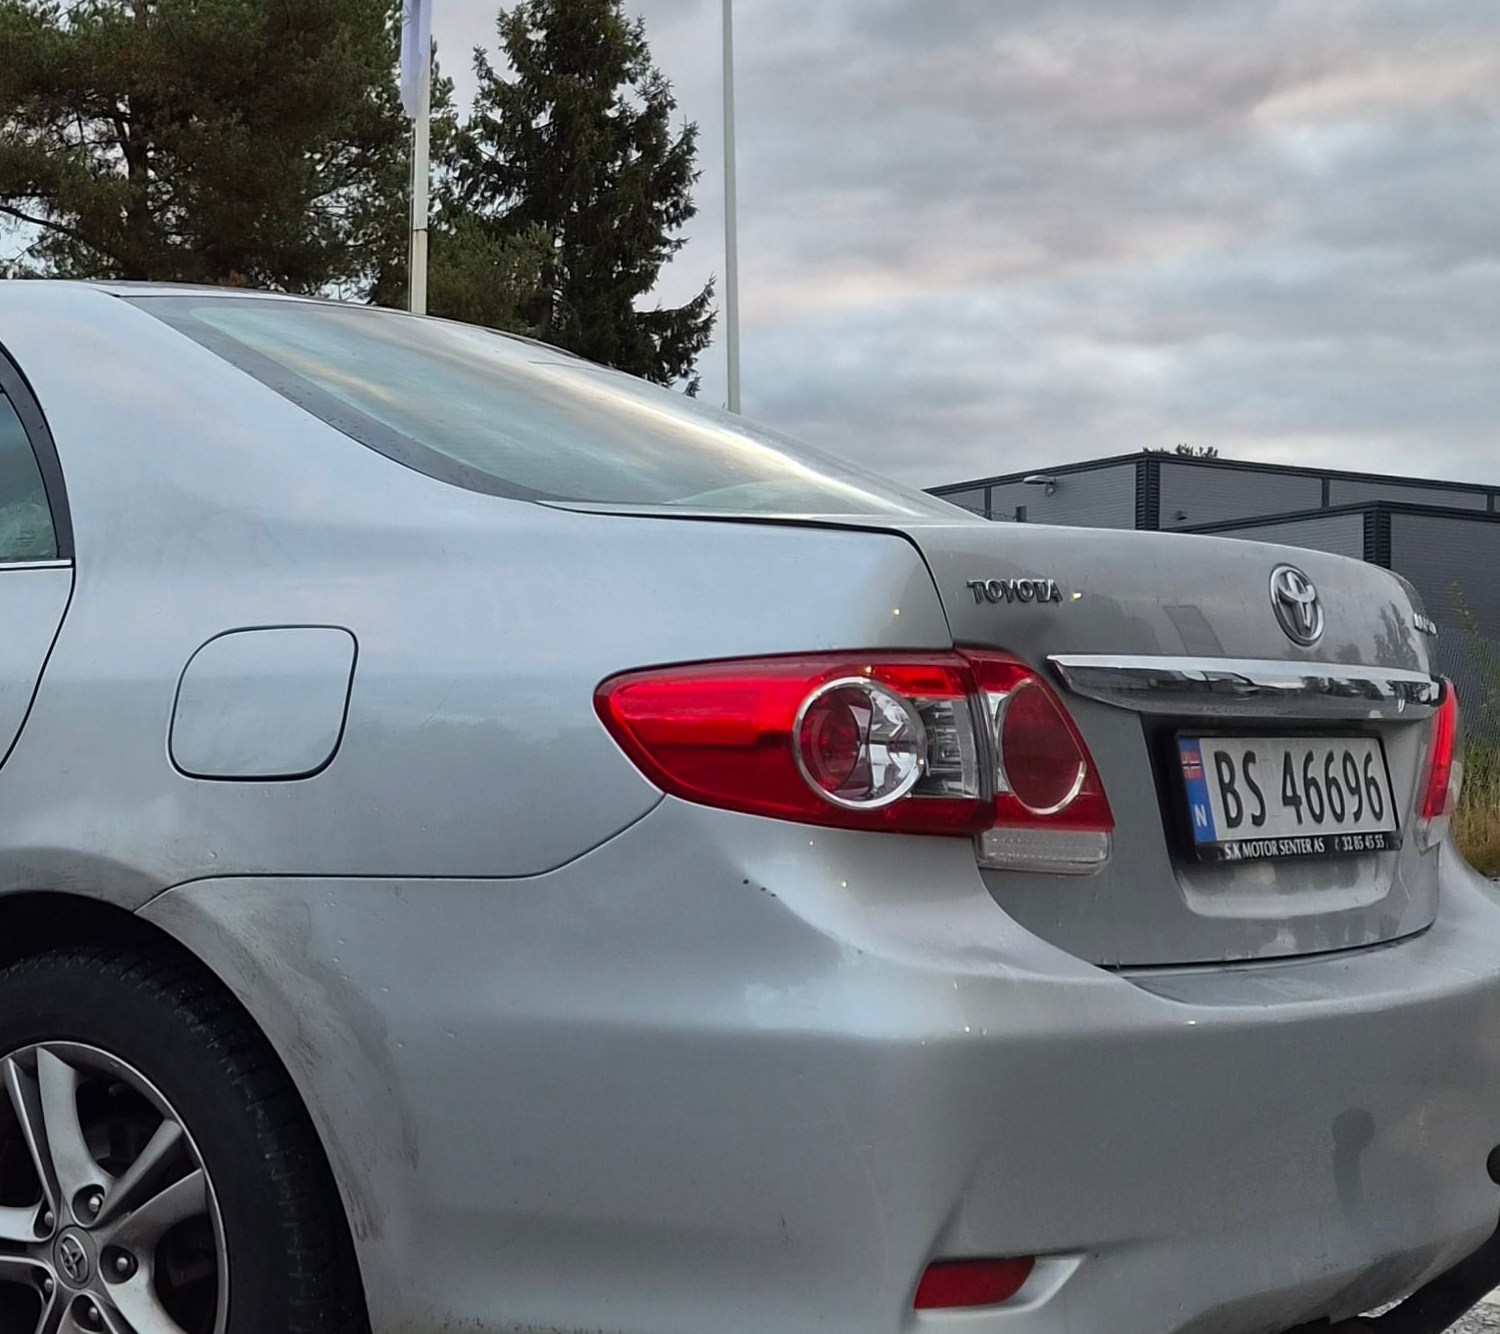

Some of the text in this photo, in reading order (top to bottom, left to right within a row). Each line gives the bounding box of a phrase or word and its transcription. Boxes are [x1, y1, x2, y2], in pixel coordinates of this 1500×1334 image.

[966, 578, 1063, 604] TOYOTA
[1214, 749, 1384, 828] BS 46696
[1194, 803, 1208, 827] N
[1242, 839, 1279, 858] MOTOR
[1279, 837, 1313, 855] SENTER
[1314, 837, 1325, 854] AS
